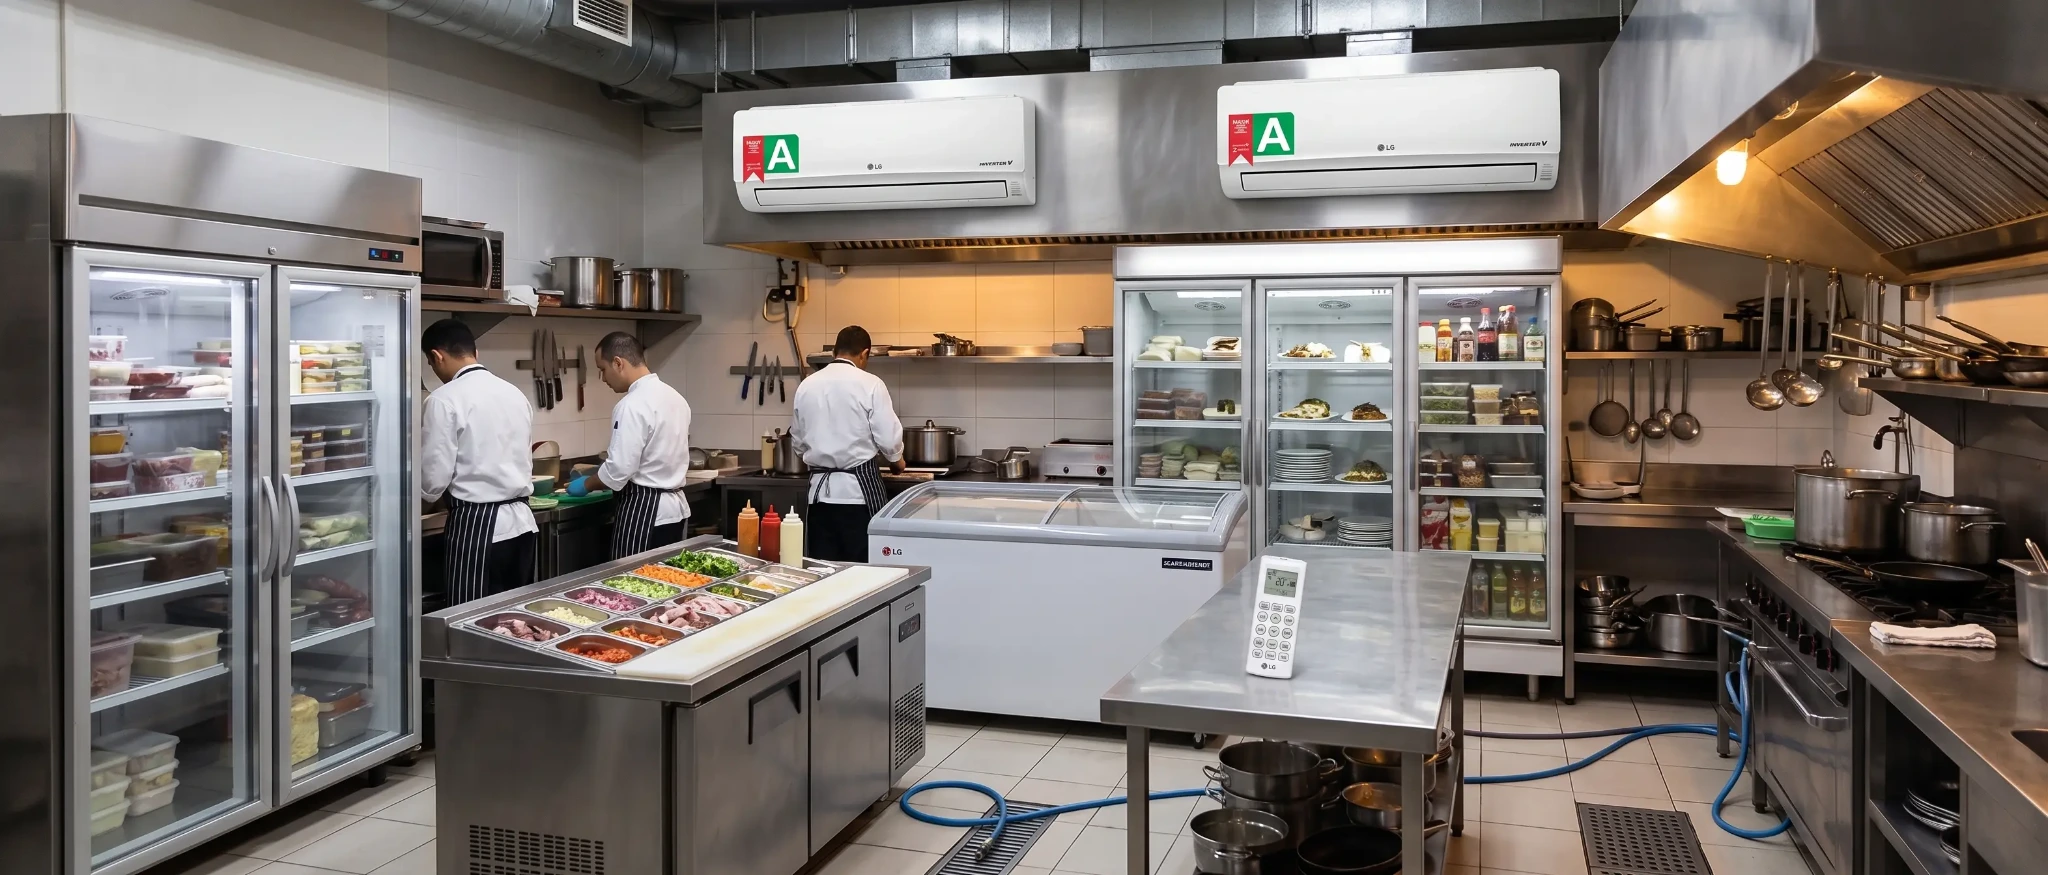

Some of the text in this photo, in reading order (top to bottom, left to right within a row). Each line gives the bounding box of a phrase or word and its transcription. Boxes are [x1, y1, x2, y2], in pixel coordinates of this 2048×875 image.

[1256, 116, 1291, 153] A
[767, 138, 796, 171] A
[893, 548, 903, 556] LG
